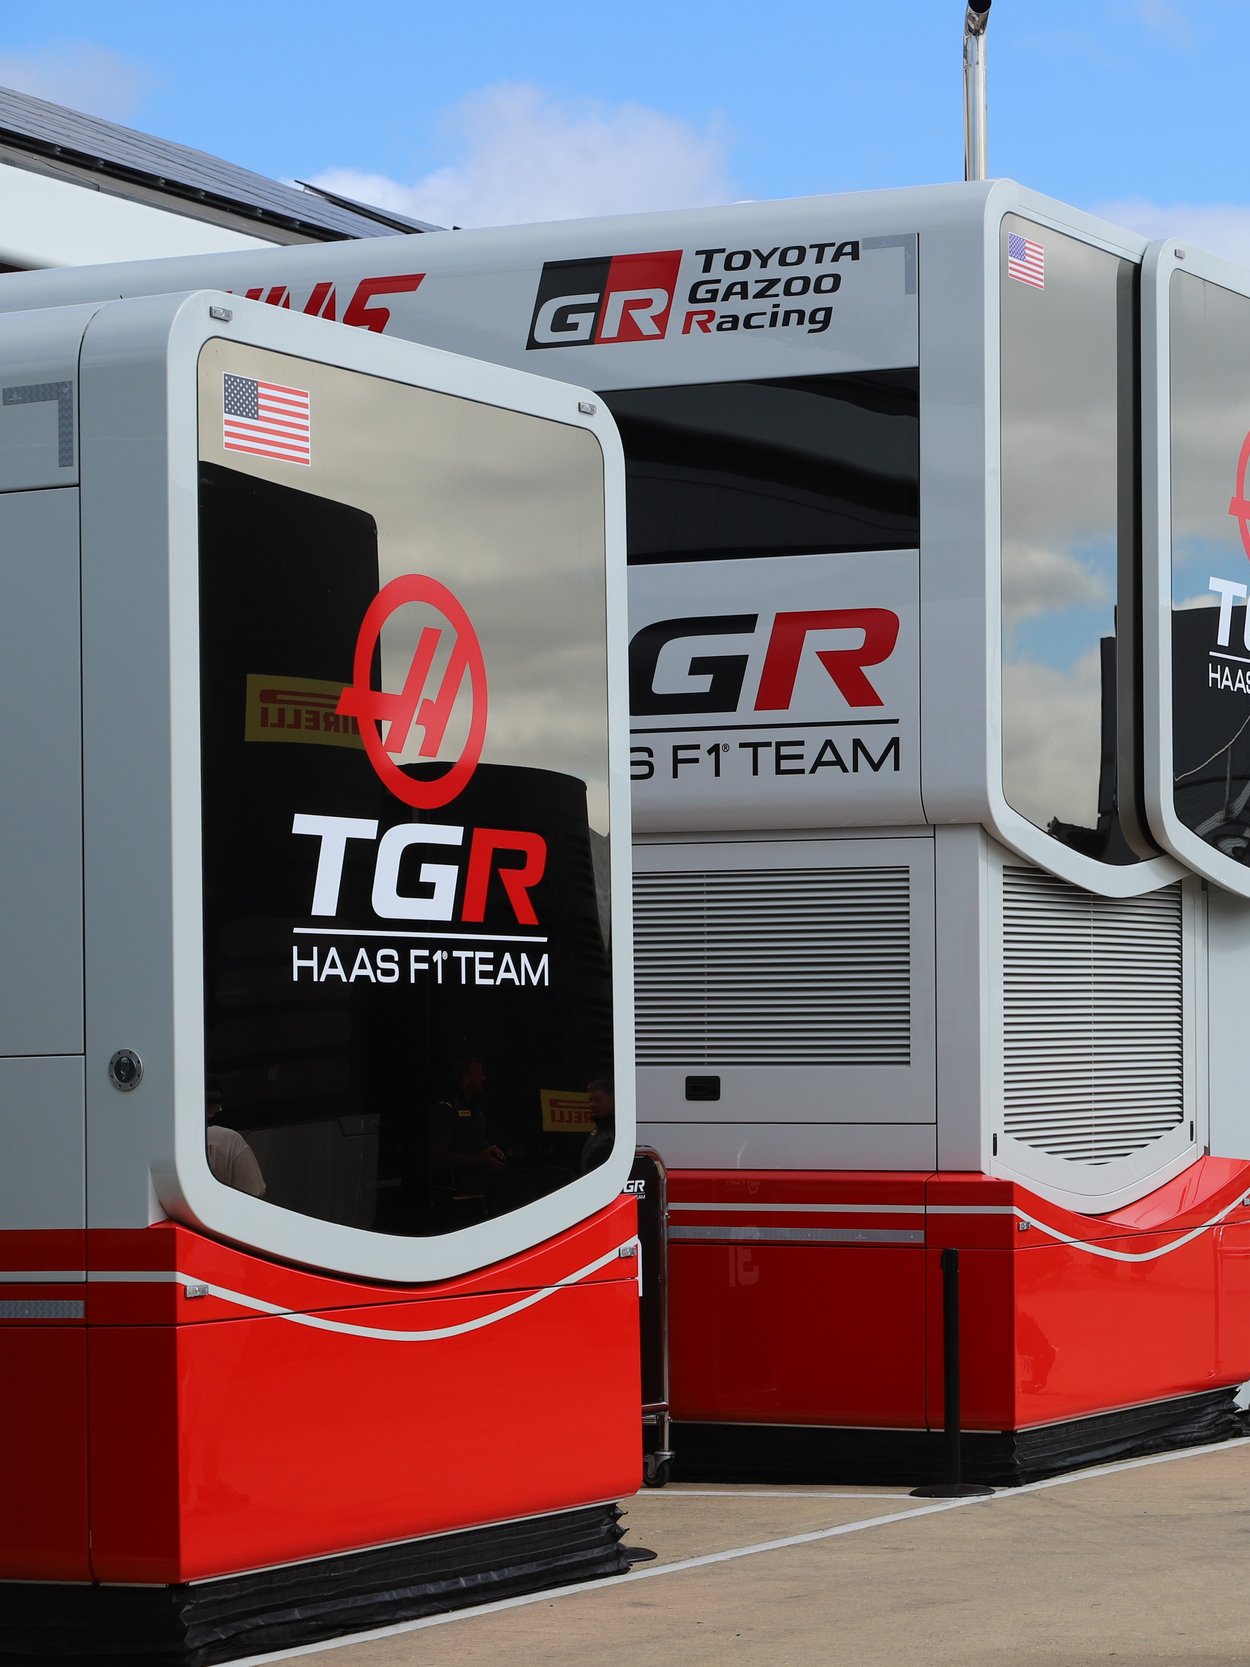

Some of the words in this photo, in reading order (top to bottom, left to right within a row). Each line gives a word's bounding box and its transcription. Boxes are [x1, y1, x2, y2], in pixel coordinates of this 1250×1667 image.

[695, 240, 860, 273] TOYOTA
[688, 273, 842, 304] GAZOO
[533, 288, 669, 344] GR
[682, 303, 833, 334] Racing
[628, 607, 900, 716] GR
[629, 746, 655, 780] S
[738, 736, 900, 777] TEAM
[291, 813, 548, 926] TGR
[292, 945, 400, 983] HAAS
[452, 950, 549, 987] TEAM
[623, 1179, 646, 1193] GR
